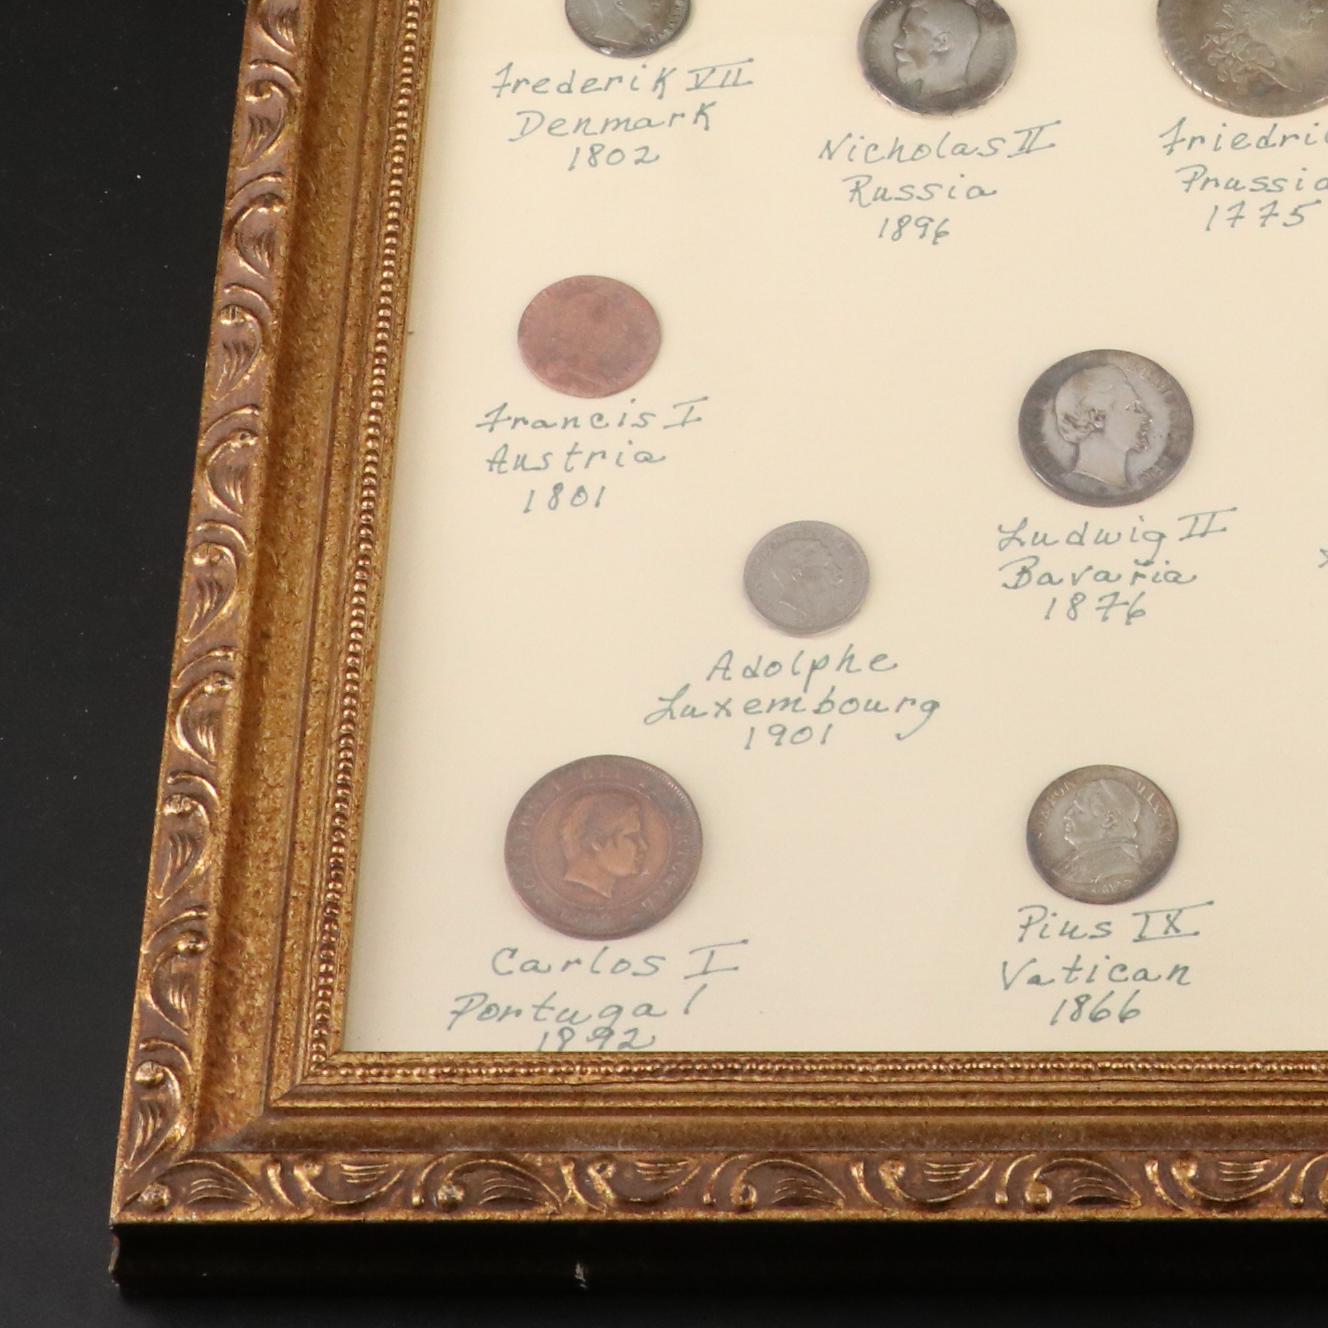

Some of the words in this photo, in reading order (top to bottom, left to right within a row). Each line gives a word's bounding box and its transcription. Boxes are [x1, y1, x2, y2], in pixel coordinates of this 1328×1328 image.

[686, 57, 754, 91] VII
[568, 143, 660, 171] 1802
[818, 131, 1006, 164] Nicholas
[1007, 120, 1061, 158] II
[842, 174, 997, 208] Russia
[878, 214, 950, 246] 1896
[1205, 198, 1322, 231] 1775
[475, 398, 656, 433] Francis
[663, 396, 709, 429] I
[486, 440, 666, 474] Austria
[523, 481, 606, 514] 1801
[998, 515, 1167, 567] Ludwig
[1177, 507, 1238, 542] II
[998, 555, 1197, 590] Bavaria
[1044, 591, 1146, 626] 1876
[706, 643, 898, 694] Adolphe
[643, 683, 940, 741] Luxembourg
[744, 723, 833, 750] 1901
[1018, 904, 1112, 943] Pius
[1132, 900, 1215, 943] IX
[491, 946, 666, 977] Carlos
[684, 939, 749, 980] I
[1002, 954, 1191, 991] Vatican
[447, 983, 707, 1030] Portugal
[1049, 989, 1141, 1026] 1866
